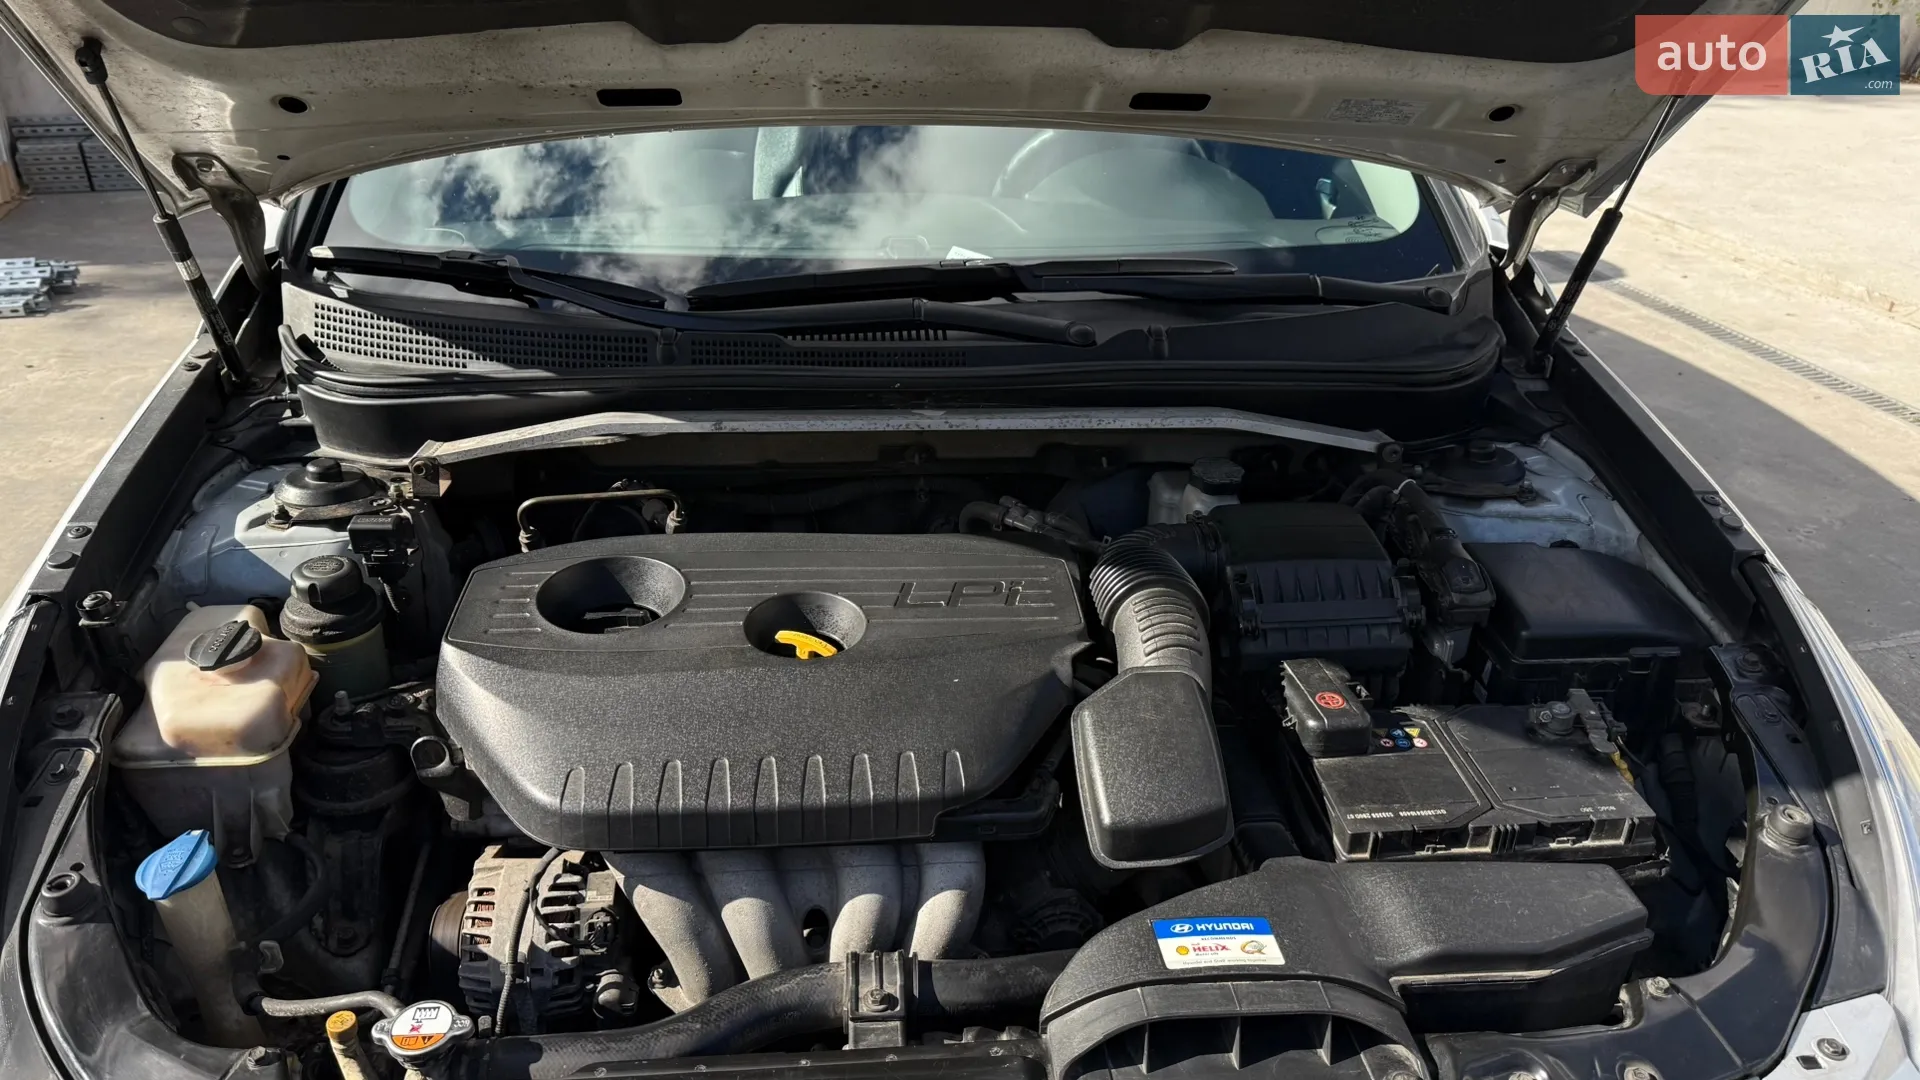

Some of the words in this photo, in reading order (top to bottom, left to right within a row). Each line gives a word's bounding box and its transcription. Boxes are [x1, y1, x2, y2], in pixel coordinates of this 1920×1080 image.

[894, 580, 1026, 607] LPi
[1196, 923, 1254, 931] HYUNDAI
[1192, 944, 1231, 953] HELIX
